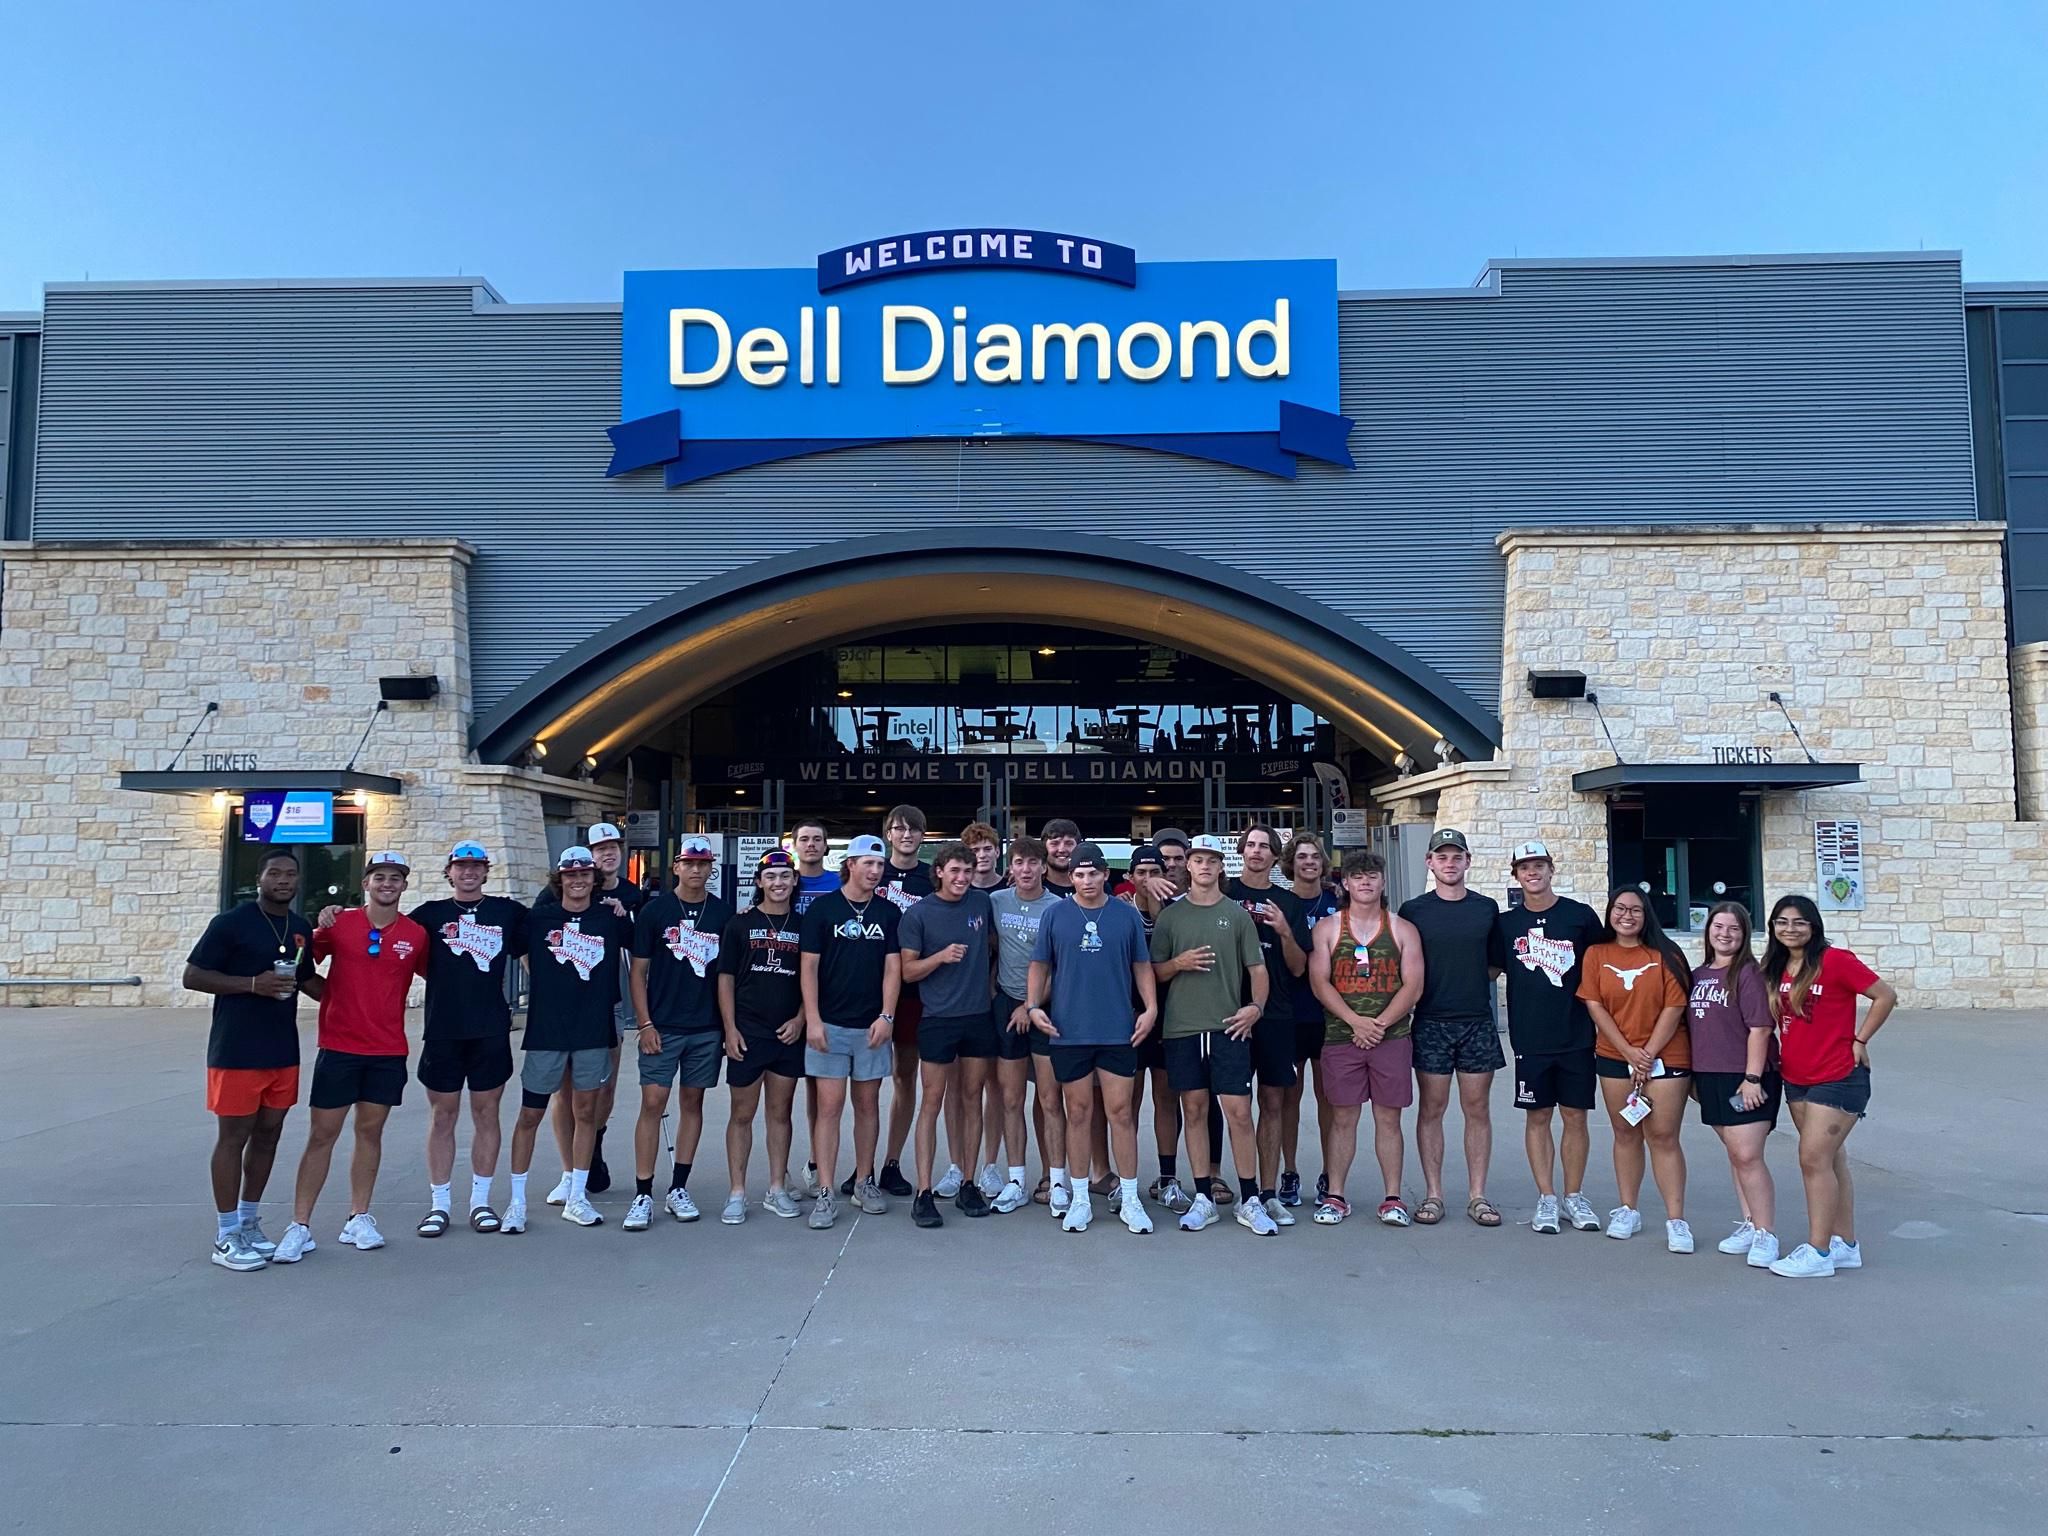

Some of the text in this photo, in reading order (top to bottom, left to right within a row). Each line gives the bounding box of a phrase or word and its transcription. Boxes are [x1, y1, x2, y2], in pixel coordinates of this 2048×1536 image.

[844, 233, 1102, 276] WELCOME TO
[669, 298, 1291, 388] Dell Diamond
[893, 718, 933, 735] intel
[202, 754, 258, 771] TICKETS
[1712, 746, 1773, 764] TICKETS
[727, 762, 765, 778] EXPRESS
[800, 760, 1226, 780] WELCOME TO DELL DIAMOND
[1261, 760, 1299, 775] EXPRESS
[1202, 837, 1212, 848] L
[1525, 845, 1537, 854] L
[384, 853, 396, 863] L
[462, 930, 496, 950] STATE
[749, 929, 768, 937] LEGACY
[566, 939, 597, 960] STATE
[682, 936, 710, 956] STATE
[750, 940, 799, 953] PLAYOFFS
[767, 949, 781, 966] L
[1532, 945, 1567, 965] STATE
[1706, 986, 1730, 1008] A&M
[1519, 1081, 1534, 1098] L
